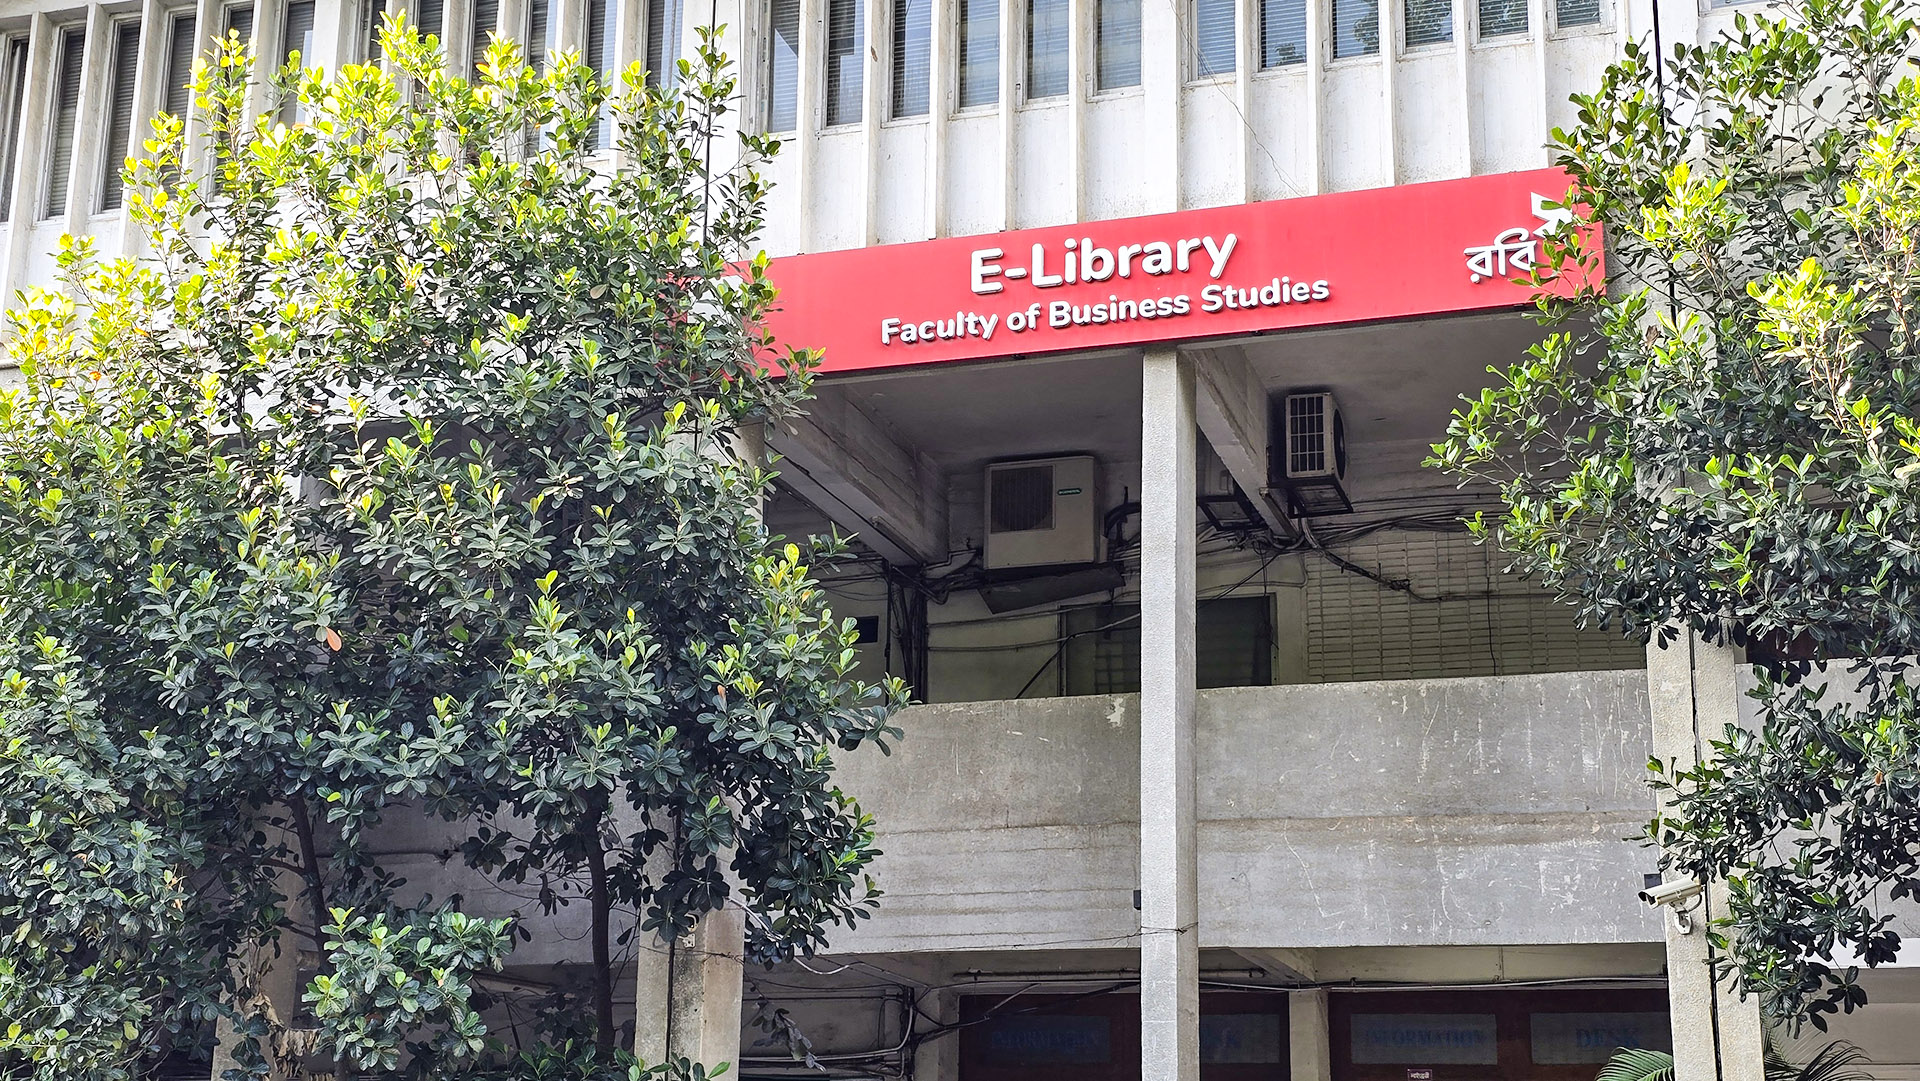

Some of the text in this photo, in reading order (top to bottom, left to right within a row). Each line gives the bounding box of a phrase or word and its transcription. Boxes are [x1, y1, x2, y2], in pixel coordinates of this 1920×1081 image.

[970, 233, 1238, 294] E-Library
[1463, 227, 1538, 284] রবি
[881, 276, 1330, 345] Faculty of Business Studies
